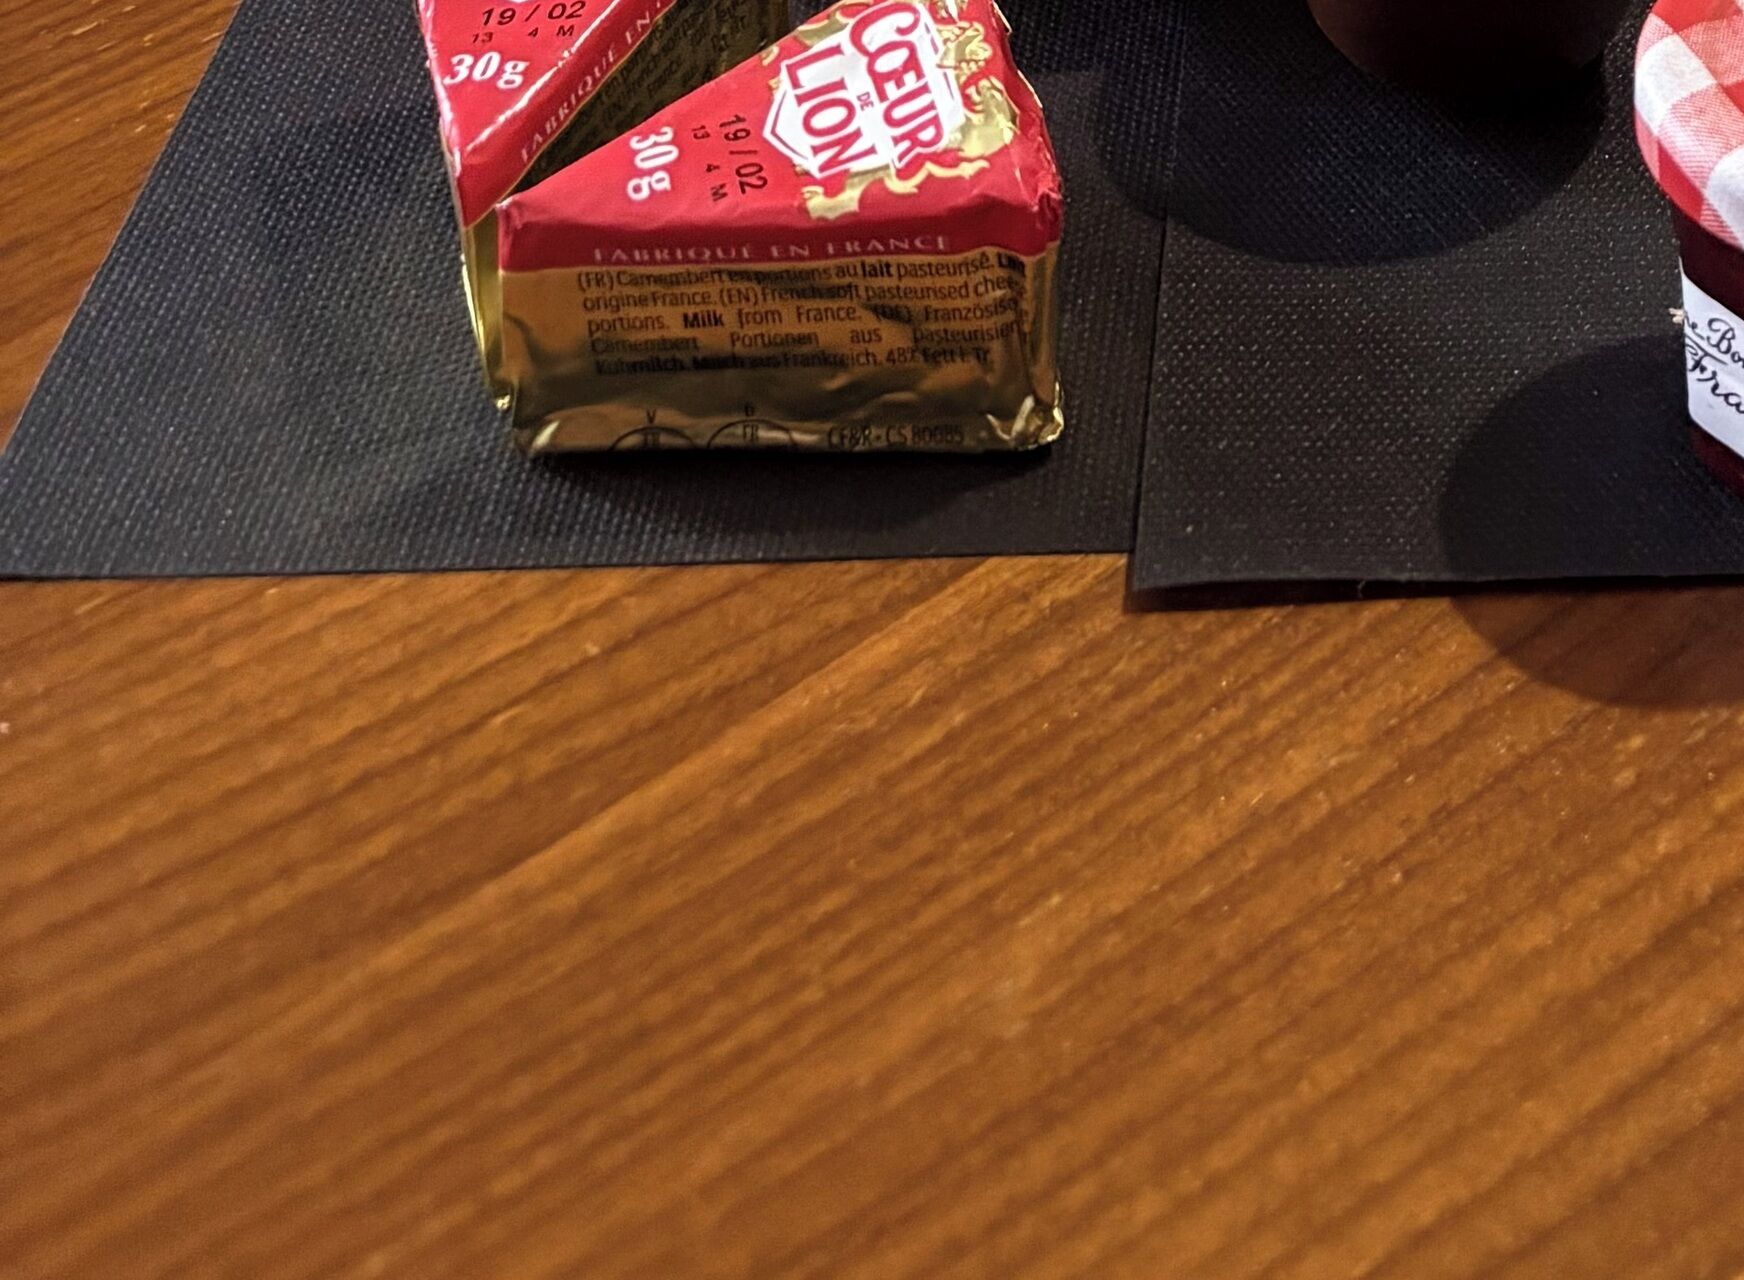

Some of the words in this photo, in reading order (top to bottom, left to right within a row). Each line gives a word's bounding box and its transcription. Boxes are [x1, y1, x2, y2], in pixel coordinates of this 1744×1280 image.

[481, 7, 516, 27] 19
[547, 0, 586, 22] 02
[443, 51, 530, 90] 30g
[847, 2, 946, 172] CŒUR
[785, 46, 879, 180] LION
[856, 90, 871, 111] DE
[627, 125, 680, 203] 30g
[718, 113, 752, 143] 19
[735, 162, 768, 195] 02
[577, 269, 615, 291] (FR)
[834, 262, 859, 280] au
[860, 259, 894, 279] lait
[896, 250, 996, 281] pasteurisé.
[582, 293, 649, 314] origine
[651, 289, 718, 308] France.
[719, 286, 759, 308] (EN)
[863, 280, 970, 304] pasteurised
[586, 314, 670, 338] portions.
[682, 309, 726, 330] Milk
[735, 307, 784, 329] from
[795, 304, 862, 324] France.
[849, 326, 884, 344] aus
